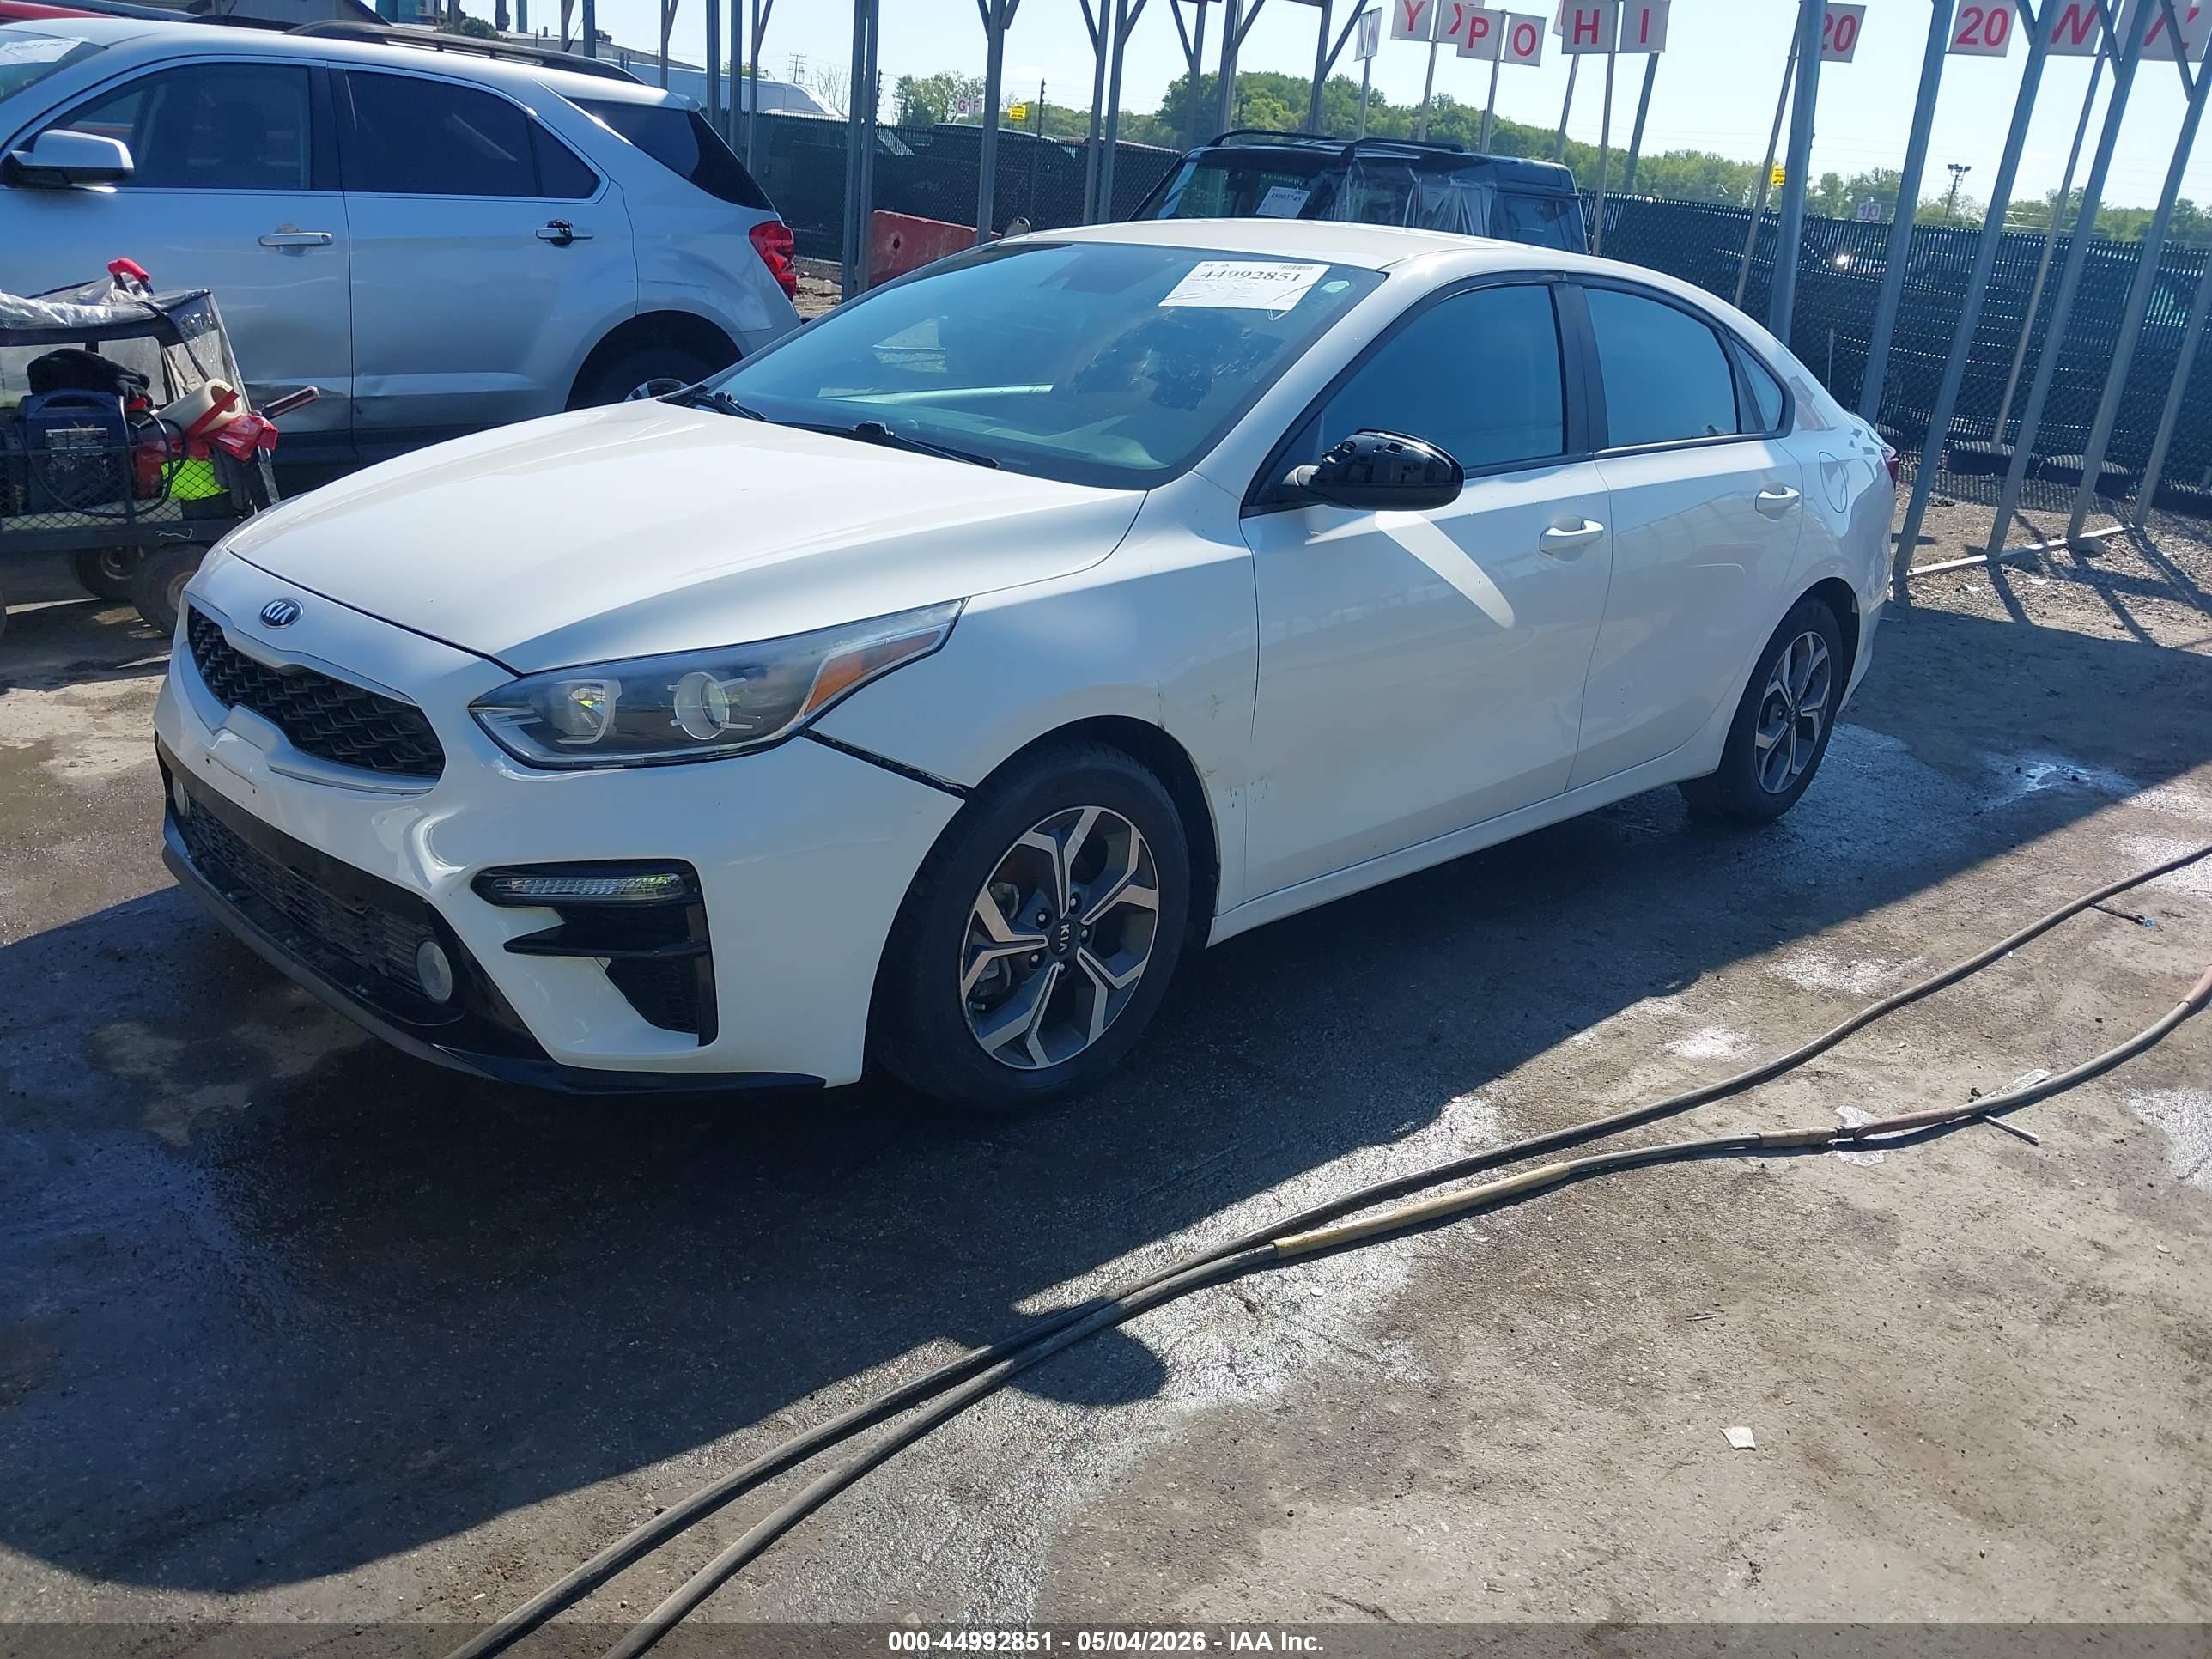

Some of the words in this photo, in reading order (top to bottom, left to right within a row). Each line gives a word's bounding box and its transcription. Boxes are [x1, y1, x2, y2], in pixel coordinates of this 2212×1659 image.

[1403, 0, 1425, 32] Y
[1573, 9, 1601, 45] H
[1955, 6, 2010, 47] 20
[1467, 16, 1490, 49] P
[1200, 270, 1302, 283] 44992851
[262, 600, 295, 624] KIA
[1058, 923, 1070, 953] KIA
